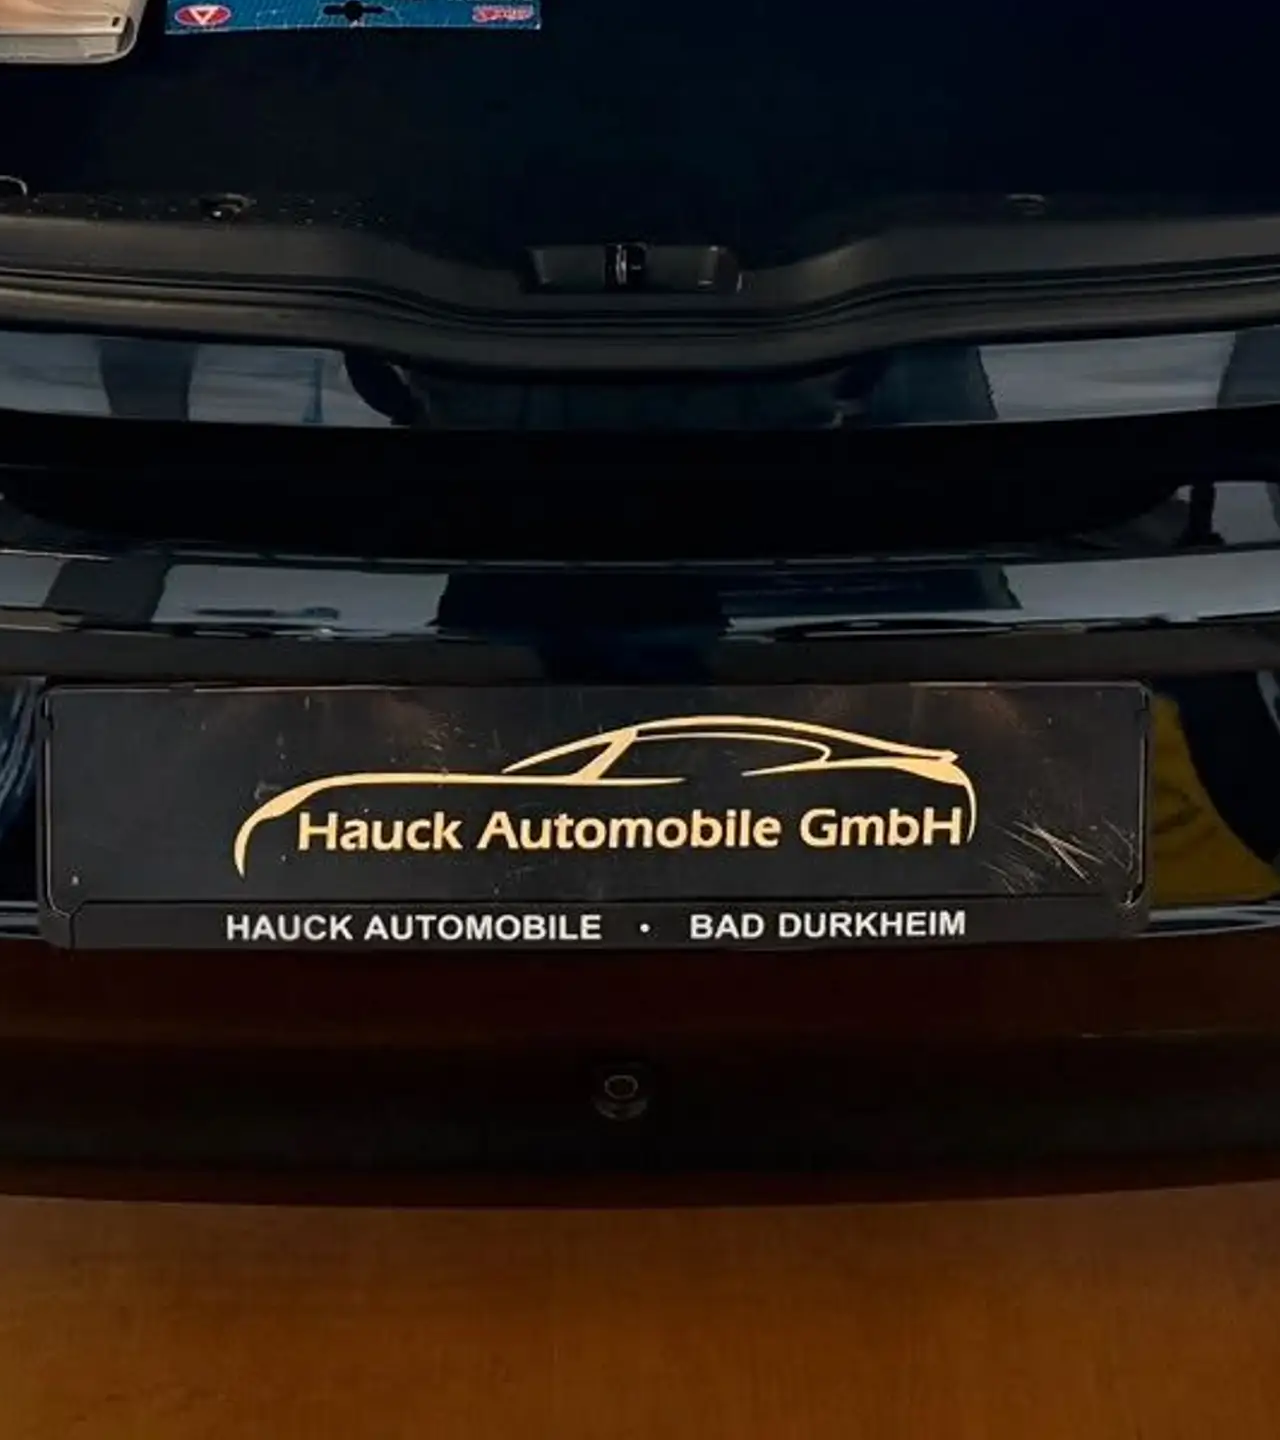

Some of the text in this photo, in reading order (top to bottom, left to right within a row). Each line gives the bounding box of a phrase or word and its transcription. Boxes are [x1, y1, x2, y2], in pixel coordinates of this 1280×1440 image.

[297, 807, 963, 851] Hauck Automobile GmbH
[227, 910, 966, 941] HAUCK AUTOMOBILE BAD DURKHEIM
